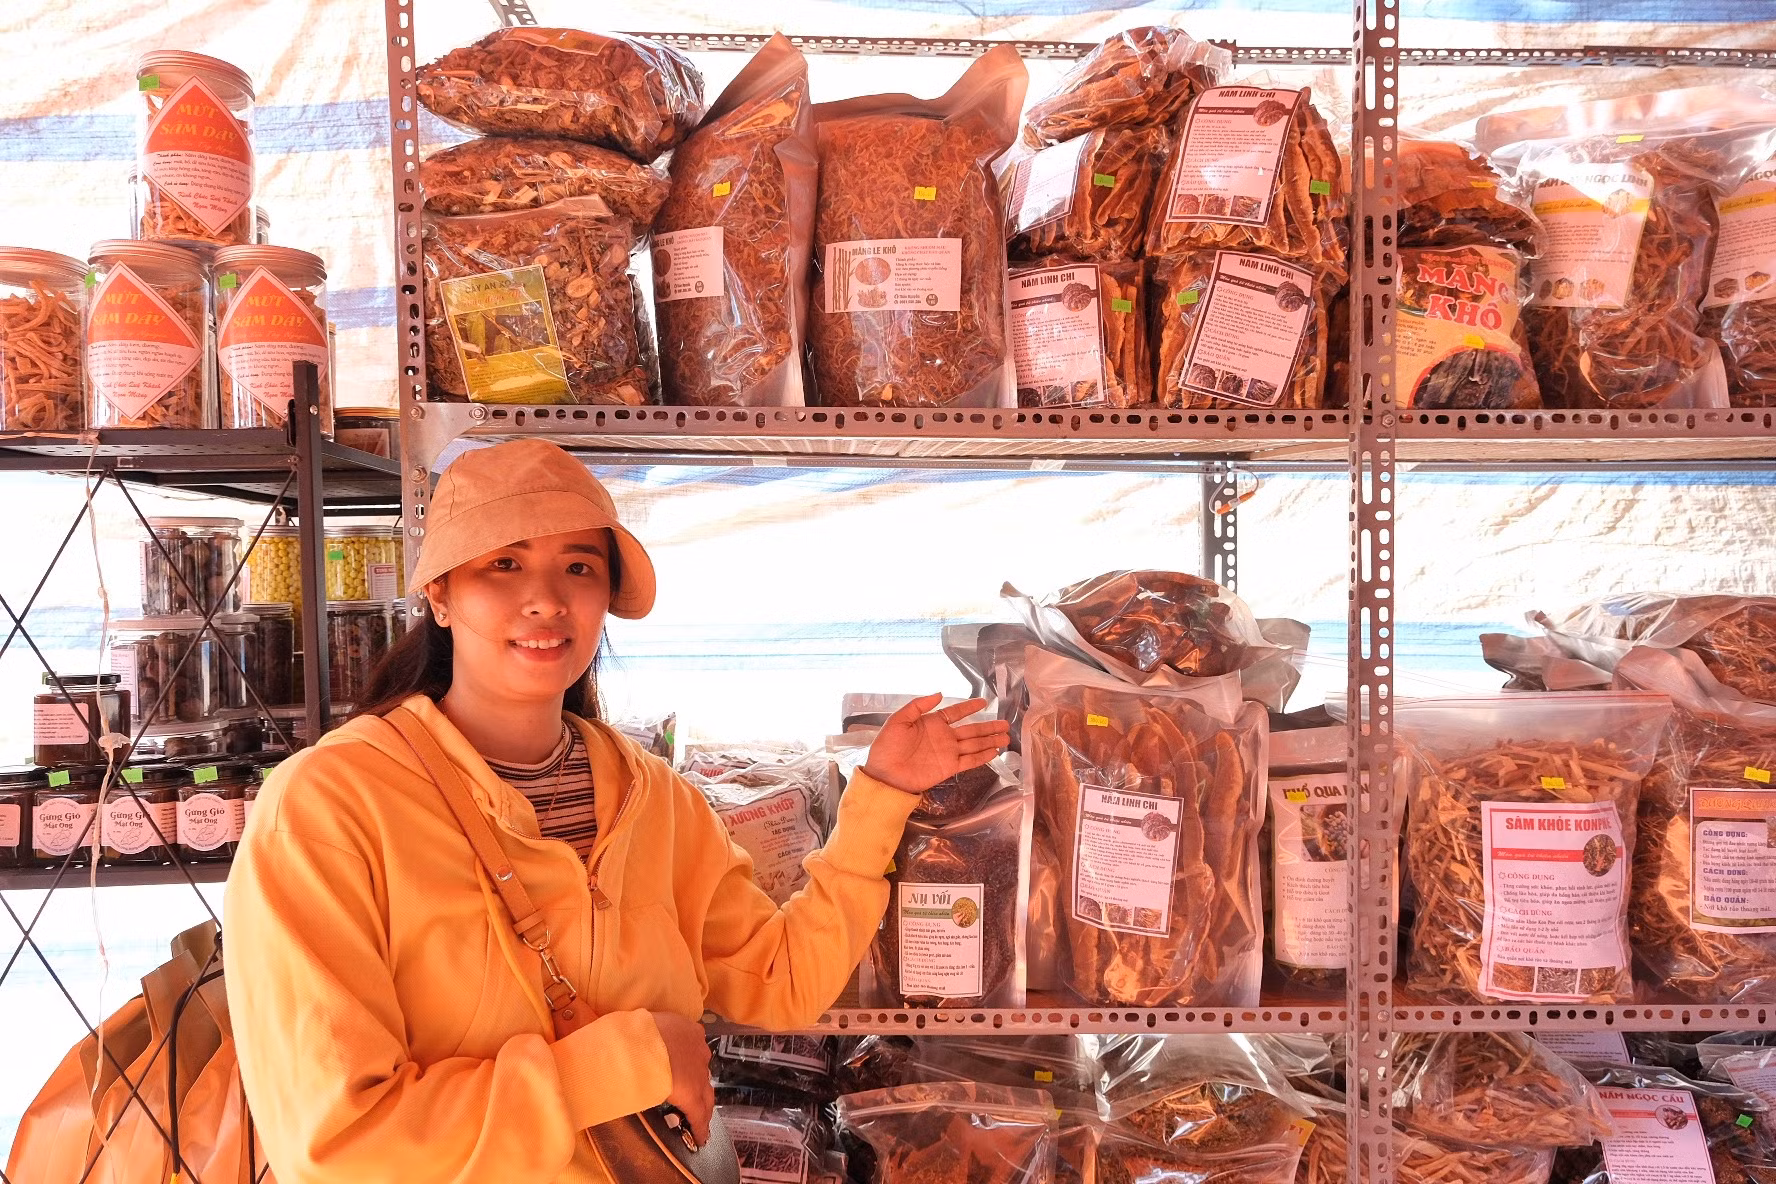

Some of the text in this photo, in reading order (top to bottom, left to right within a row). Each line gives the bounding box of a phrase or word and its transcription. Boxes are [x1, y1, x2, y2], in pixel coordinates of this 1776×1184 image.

[873, 247, 881, 255] LE
[1040, 275, 1058, 284] LINH
[1060, 272, 1075, 282] CHI
[1260, 263, 1280, 275] LINH
[1281, 268, 1295, 280] CHI
[1424, 294, 1502, 331] KHÔ
[1314, 785, 1342, 799] QUA
[1122, 797, 1141, 809] LINH
[1143, 800, 1158, 810] CHI
[1505, 816, 1534, 830] SÂM
[1537, 816, 1571, 831] KHỎE
[1703, 829, 1723, 837] CÔNG
[1507, 872, 1530, 880] CÔNG
